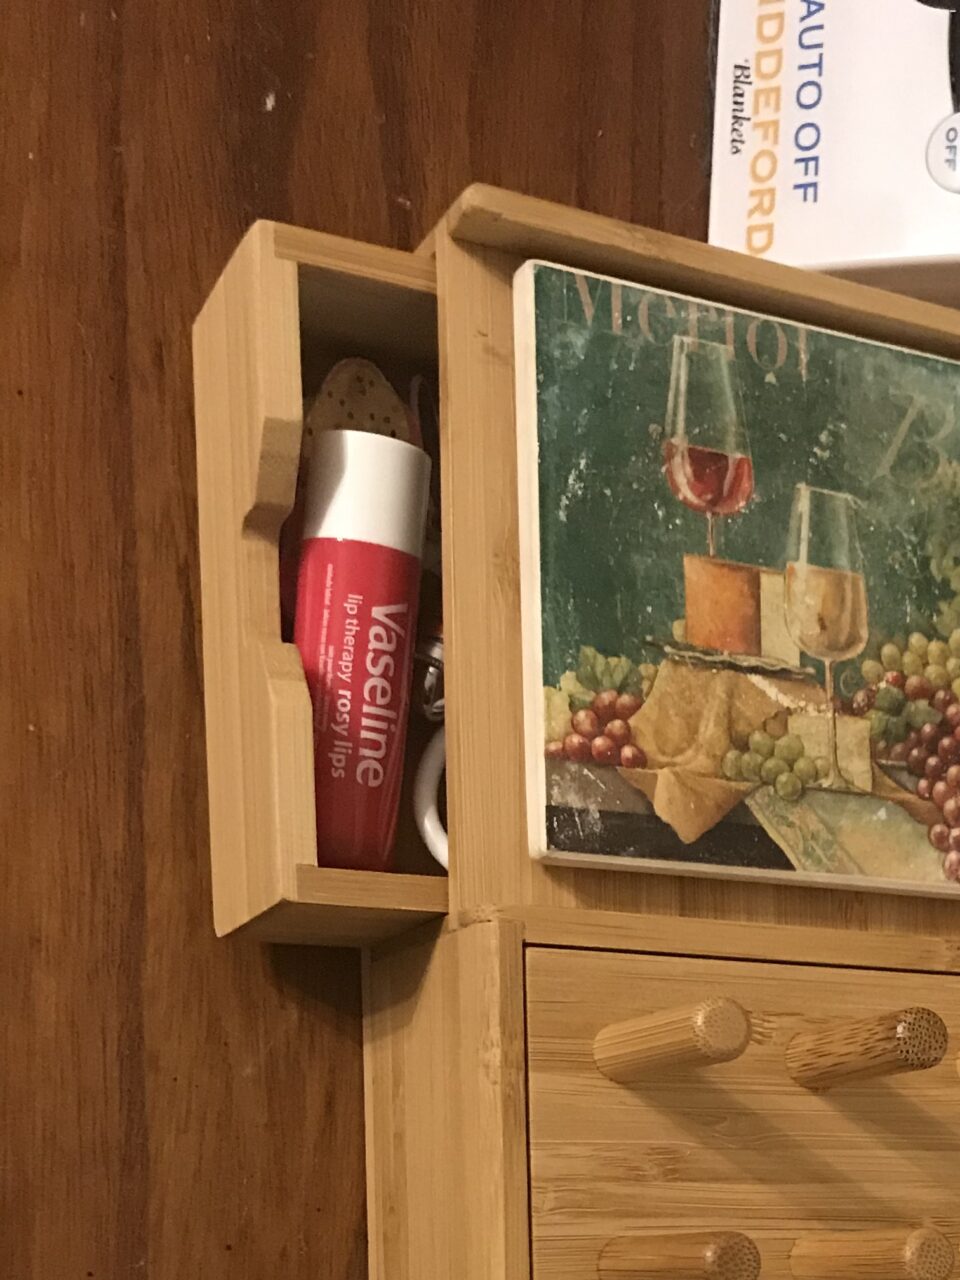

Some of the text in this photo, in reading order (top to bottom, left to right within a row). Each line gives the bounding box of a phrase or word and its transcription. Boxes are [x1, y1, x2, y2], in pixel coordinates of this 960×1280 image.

[730, 64, 753, 155] Blankets
[793, 0, 825, 204] AUTO OFF
[944, 127, 958, 172] OFF
[344, 593, 363, 615] lip
[337, 616, 360, 684] therapy
[331, 689, 351, 737] rosy
[355, 602, 408, 788] Vaseline
[328, 740, 352, 778] lips
